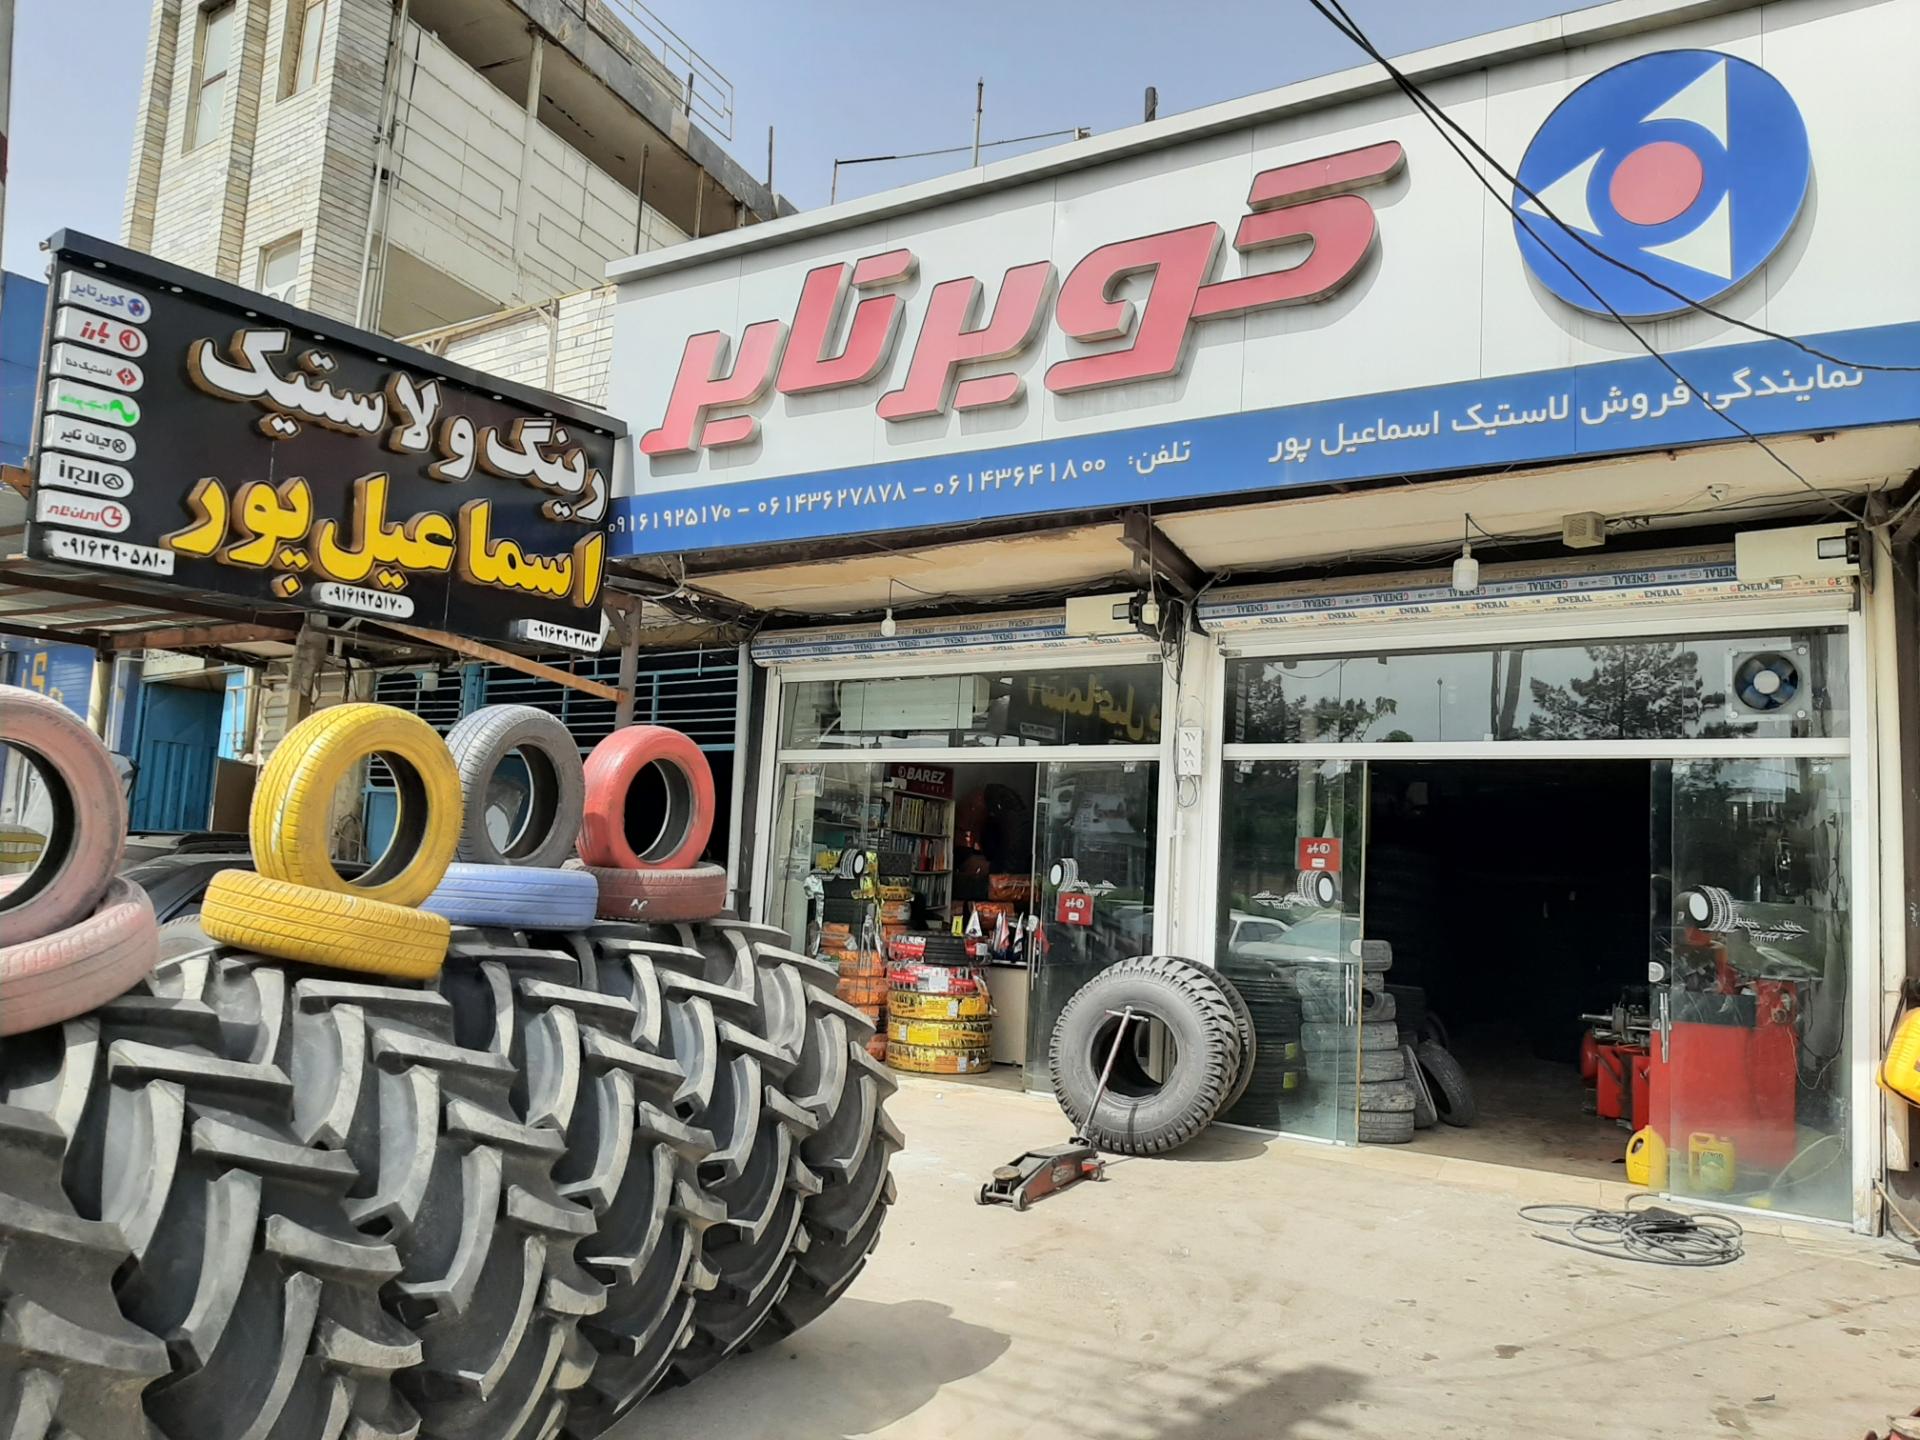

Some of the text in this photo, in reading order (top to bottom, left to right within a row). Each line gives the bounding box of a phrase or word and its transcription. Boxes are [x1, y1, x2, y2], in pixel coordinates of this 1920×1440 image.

[192, 328, 443, 453] لاستیک
[1580, 378, 1691, 425] فروش
[1703, 364, 1864, 411] نمایندگی
[1320, 410, 1440, 456] اسماعیل
[1451, 394, 1569, 437] لاستیک
[482, 417, 609, 522] رینگ
[1128, 440, 1191, 474] تلفن:
[1268, 434, 1313, 463] پور
[758, 480, 906, 516] ۰۶۱۴۳۶۲۷۸۷۸
[934, 459, 1106, 495] ۰۶۱۴۳۶۴۱۸۰۰
[608, 504, 731, 533] ۰۹۱۶۱۹۲۵۱۷۰
[163, 473, 605, 608] اسماعیل پور
[906, 766, 946, 785] BAREZ
